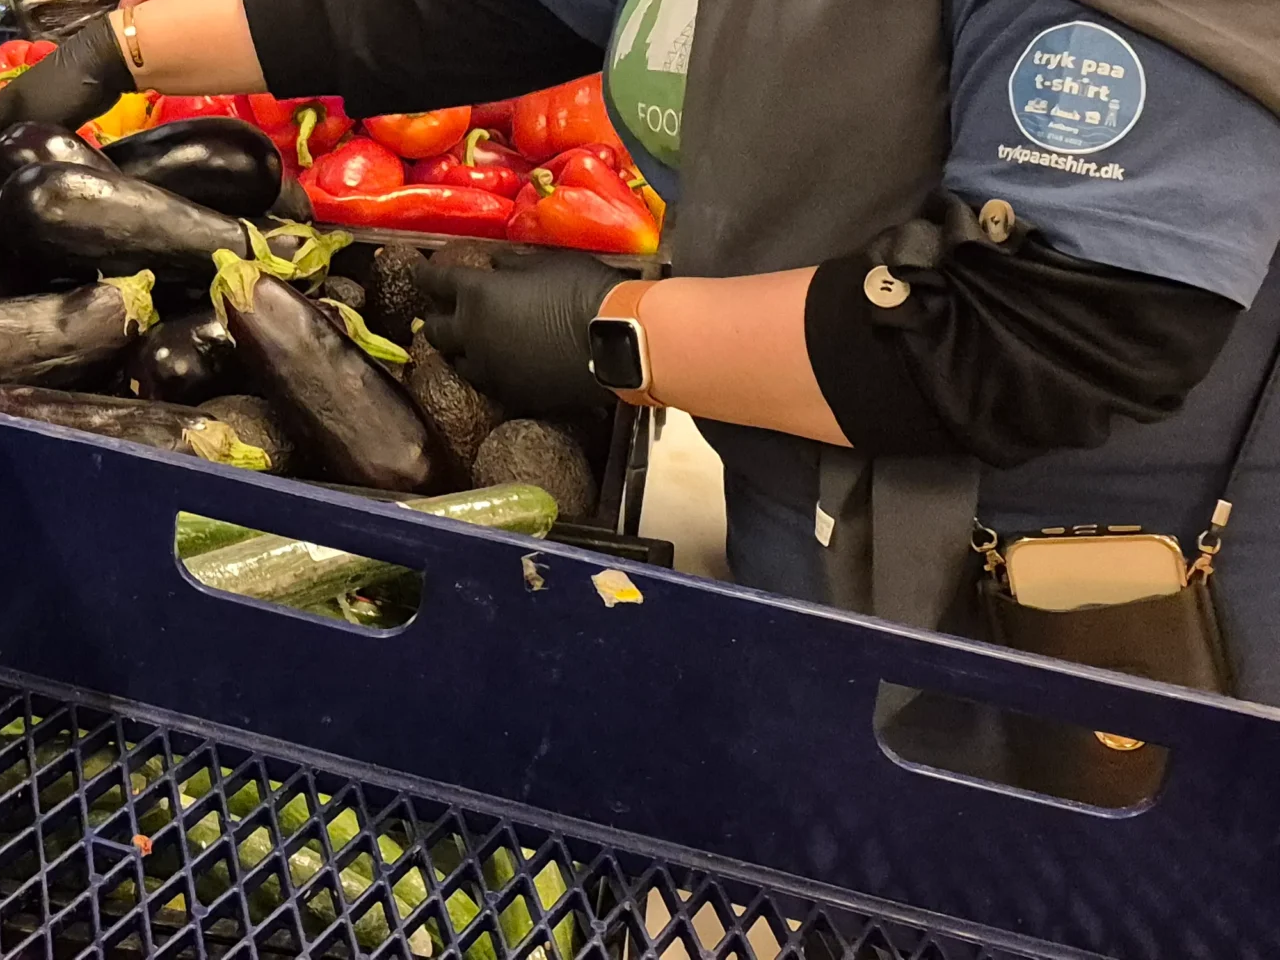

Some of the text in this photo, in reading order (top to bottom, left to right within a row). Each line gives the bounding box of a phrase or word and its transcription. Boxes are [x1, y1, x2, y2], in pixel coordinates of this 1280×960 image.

[1033, 50, 1125, 79] tryk paa
[1035, 74, 1111, 101] t-shirt
[637, 102, 682, 136] FOO
[998, 144, 1126, 181] trykpaatshirt.dk
